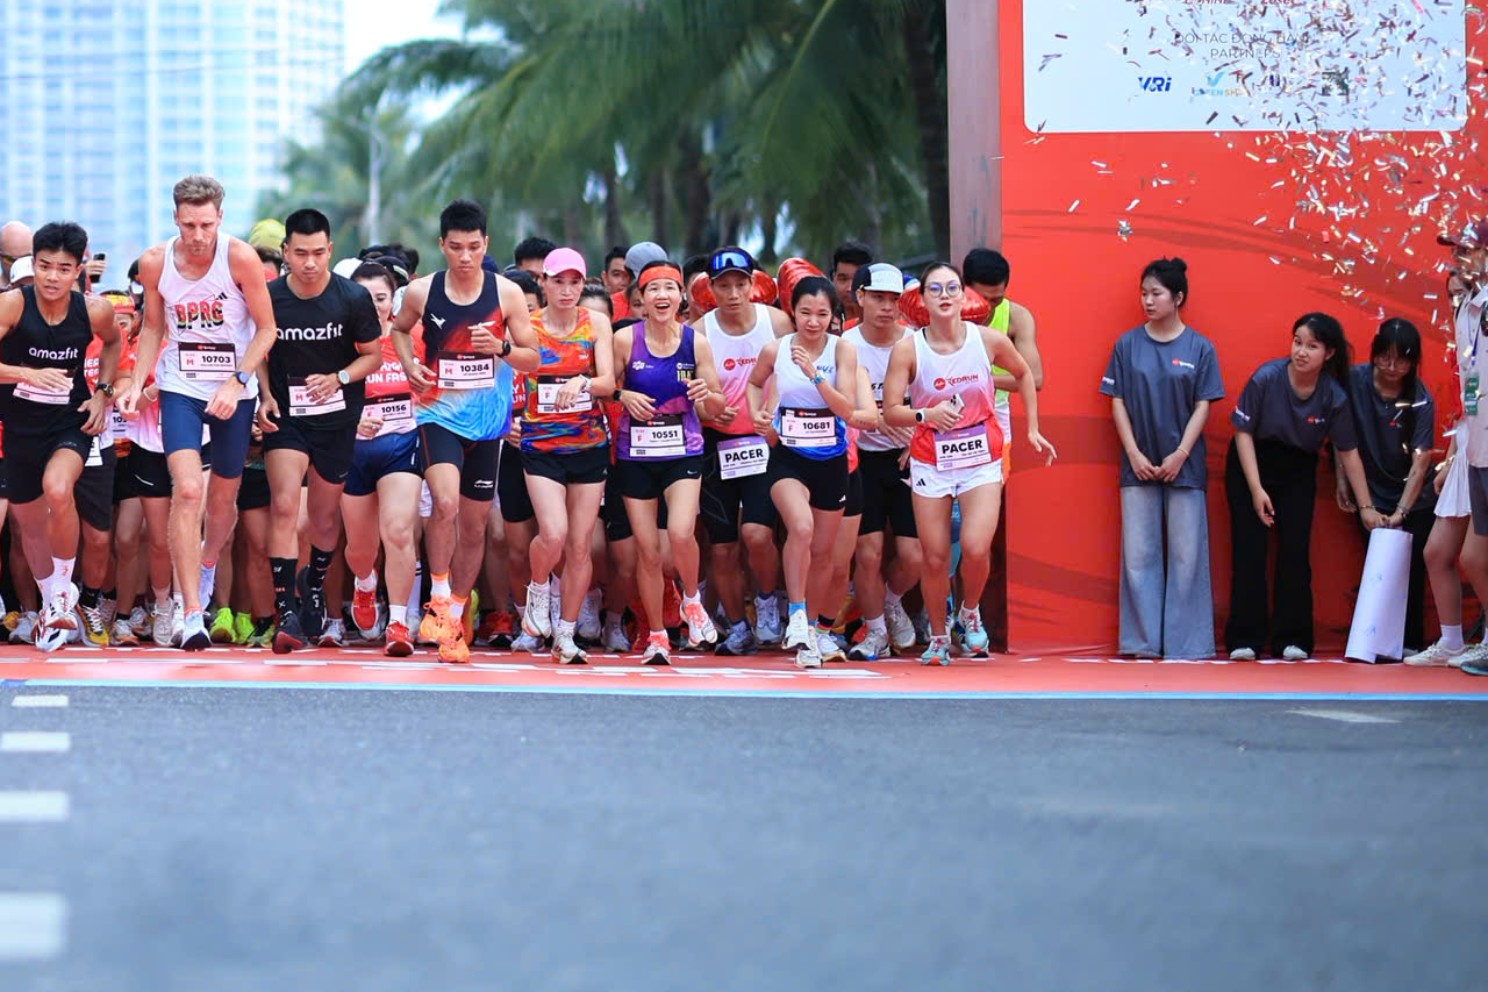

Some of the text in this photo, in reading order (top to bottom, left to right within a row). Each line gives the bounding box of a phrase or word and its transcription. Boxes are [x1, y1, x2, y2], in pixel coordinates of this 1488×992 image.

[29, 347, 79, 360] amazfit
[202, 355, 231, 363] 10703
[460, 364, 489, 373] 10384
[381, 404, 407, 414] 10156
[803, 421, 830, 430] 10681
[652, 430, 678, 439] 10551
[941, 439, 983, 454] PACER
[725, 448, 764, 463] PACER
